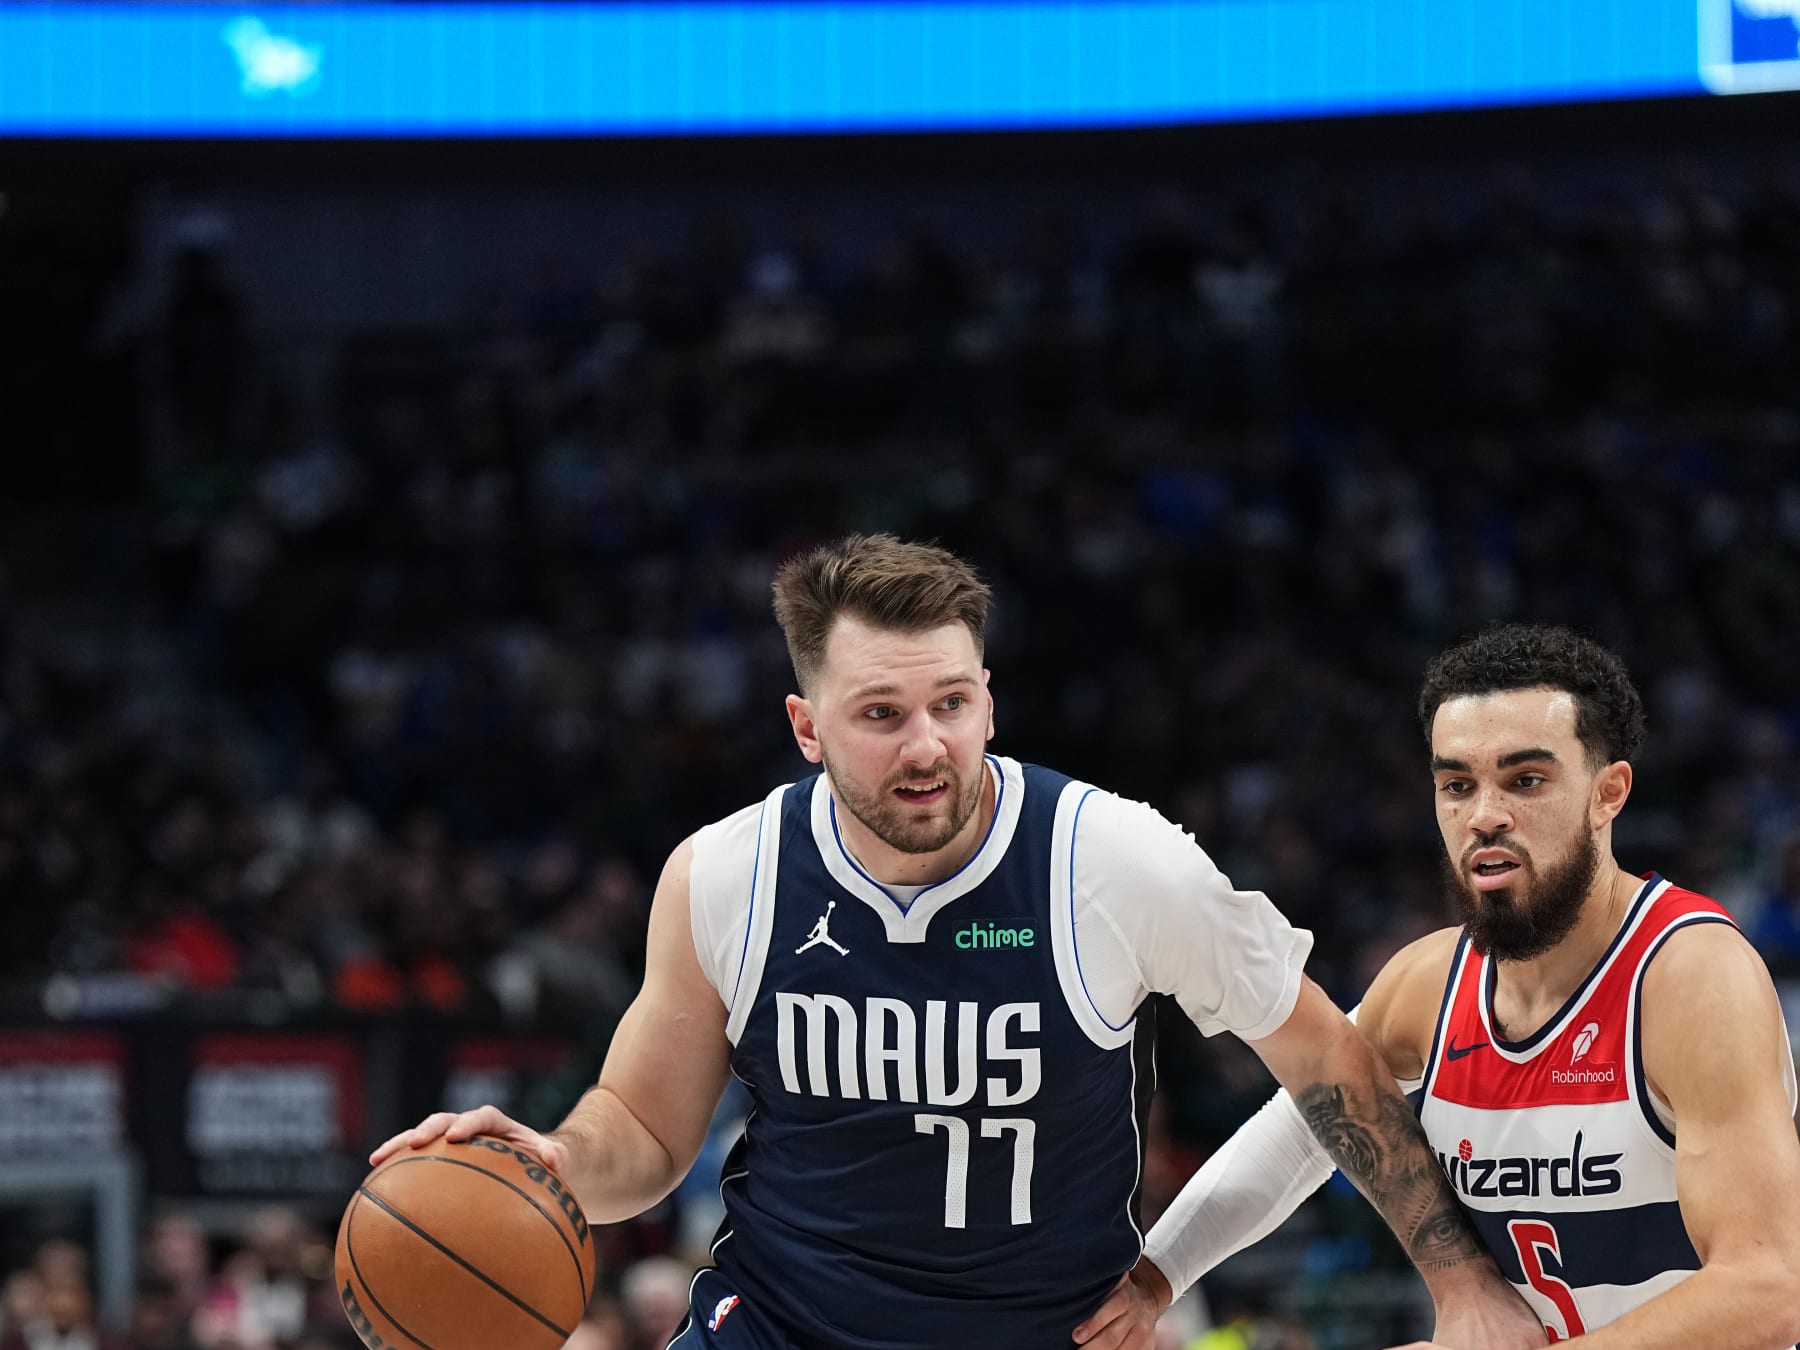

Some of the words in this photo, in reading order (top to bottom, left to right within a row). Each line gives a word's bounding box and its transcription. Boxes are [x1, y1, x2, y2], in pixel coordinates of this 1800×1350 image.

[954, 922, 1035, 949] chime
[1551, 1067, 1615, 1084] Robinhood
[914, 1113, 1036, 1229] 77
[1507, 1219, 1587, 1345] 5
